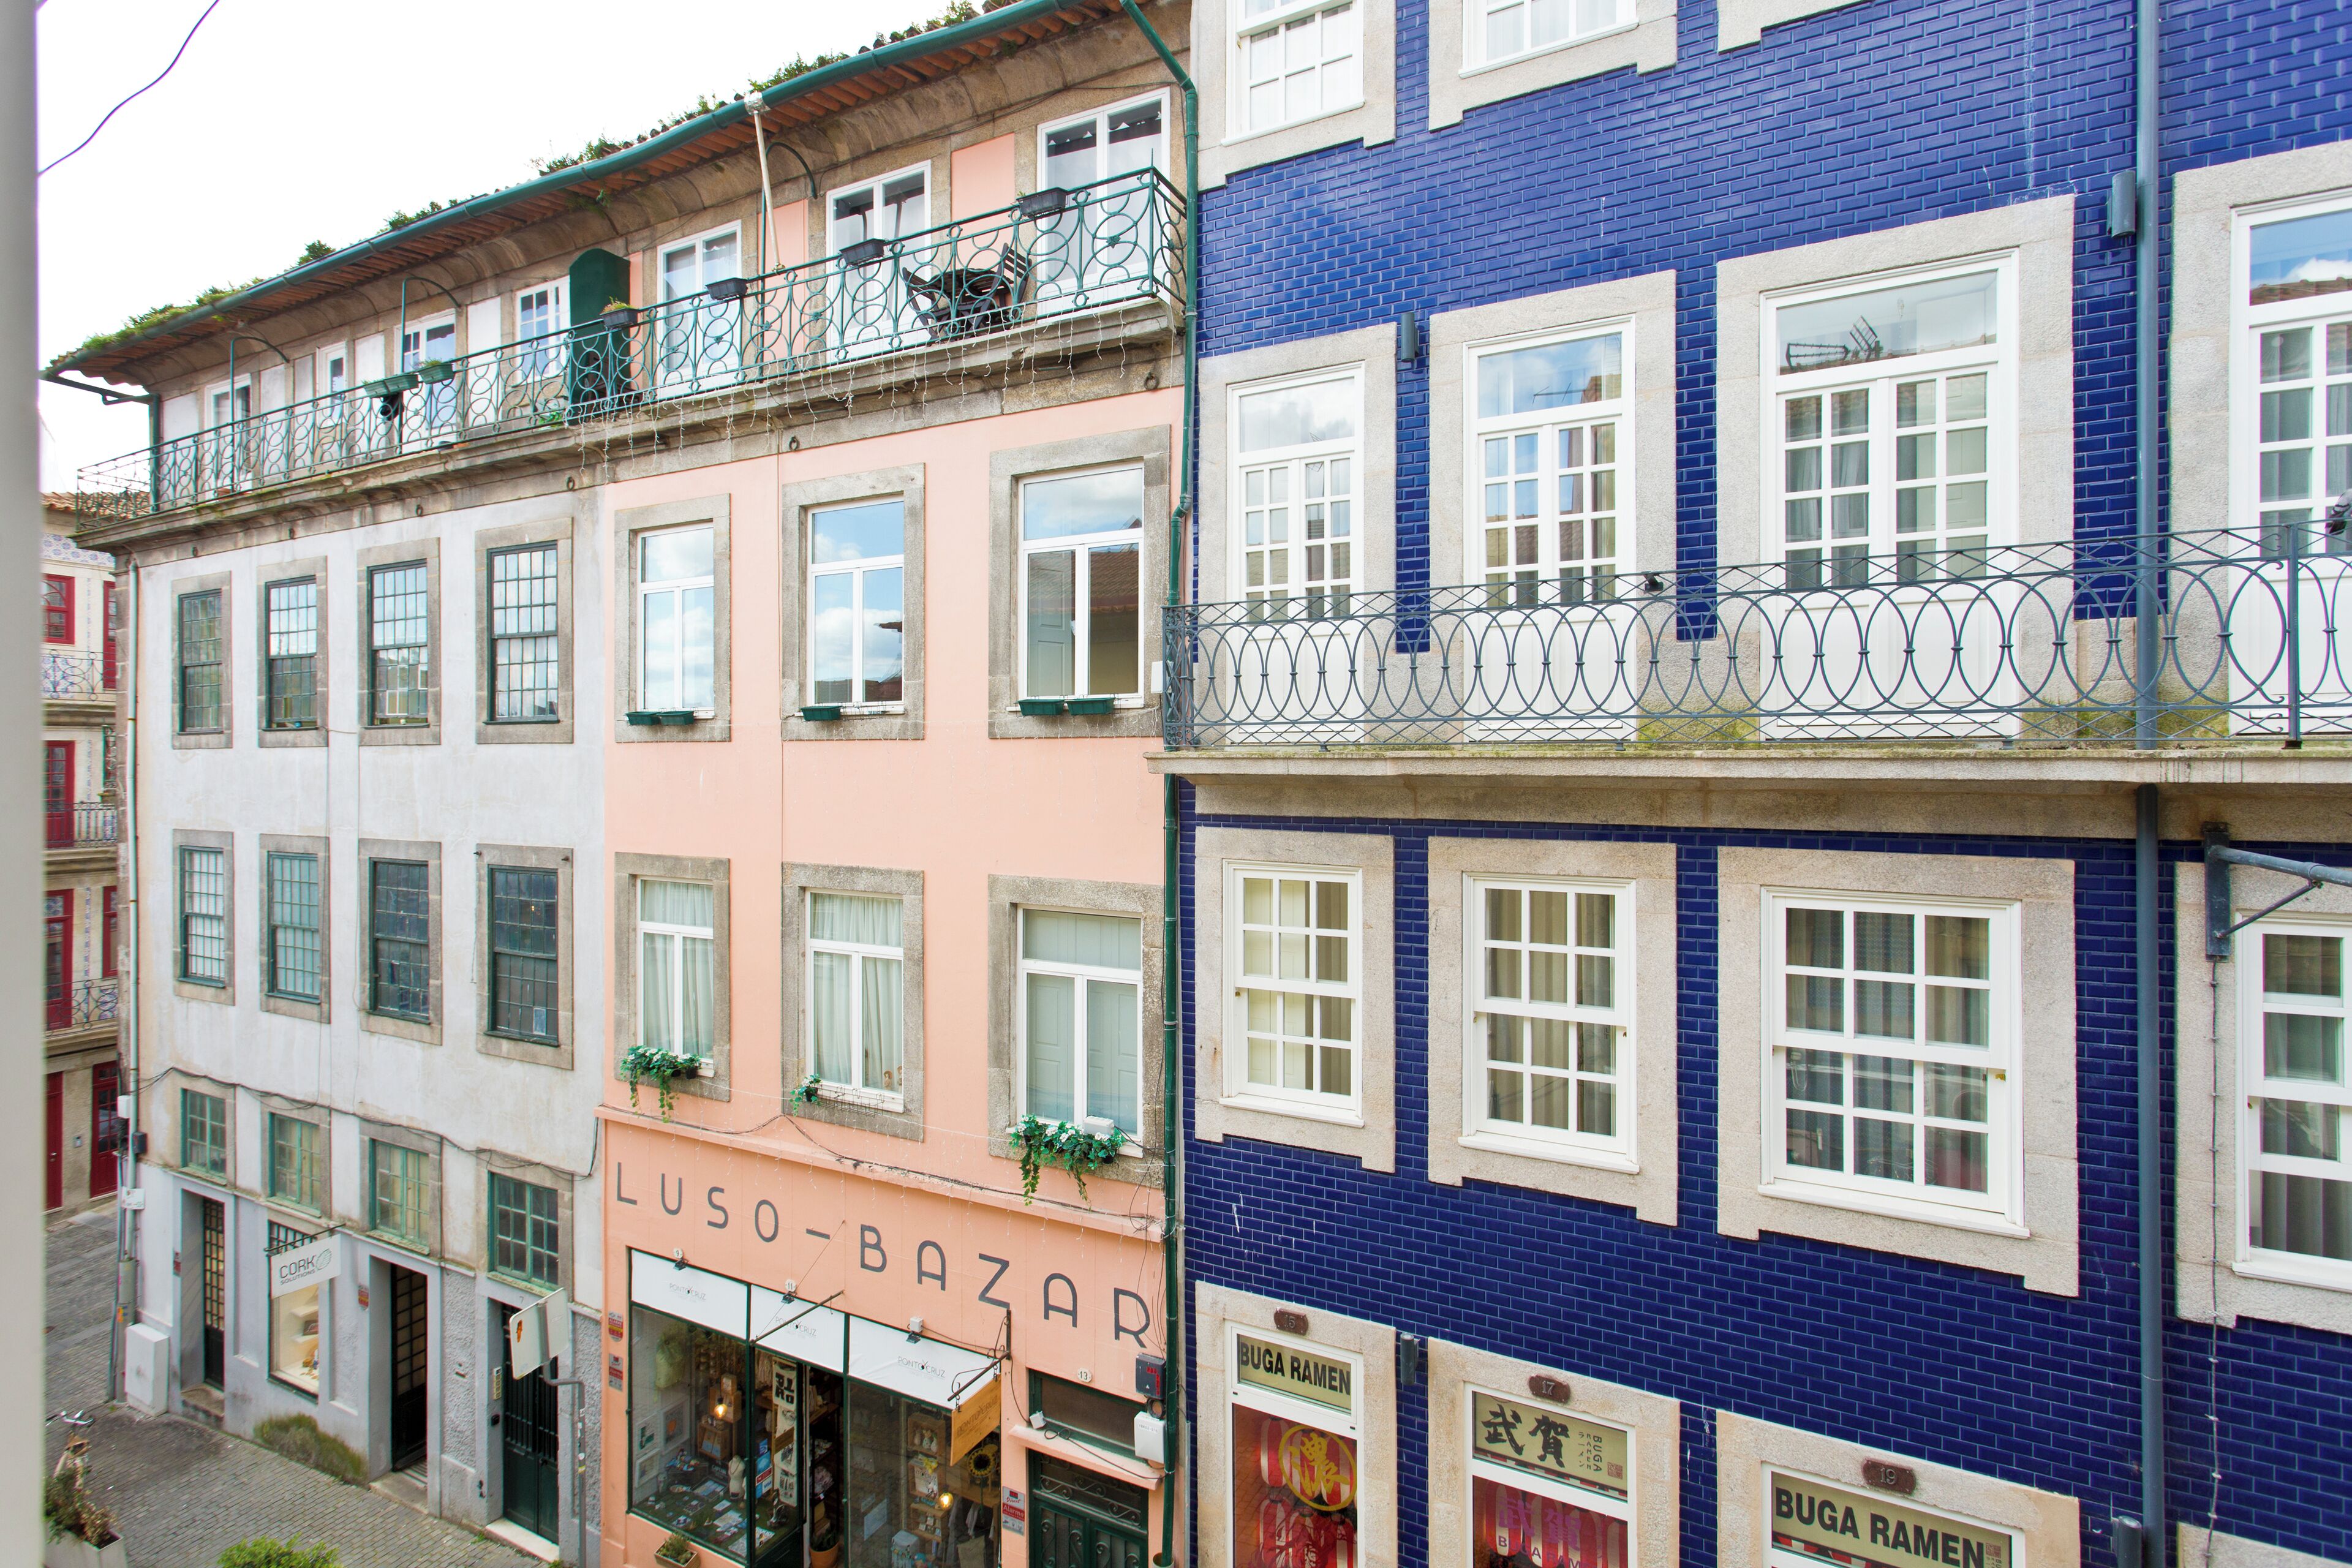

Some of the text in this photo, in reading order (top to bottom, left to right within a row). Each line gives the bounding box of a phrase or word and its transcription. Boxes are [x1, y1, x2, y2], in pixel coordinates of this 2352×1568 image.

[280, 1254, 316, 1278] CORK
[281, 1269, 315, 1285] SOLUTIONS
[1284, 1315, 1296, 1329] 15
[1080, 1370, 1088, 1381] 13
[1240, 1341, 1351, 1395] BUGA RAMEN
[1542, 1380, 1555, 1396] 17
[1482, 1403, 1570, 1468] 武賀
[1593, 1435, 1602, 1472] BUGA
[1880, 1468, 1896, 1485] 19
[1776, 1487, 1984, 1568] BUGA RAMEN
[1498, 1536, 1542, 1559] BUGA
